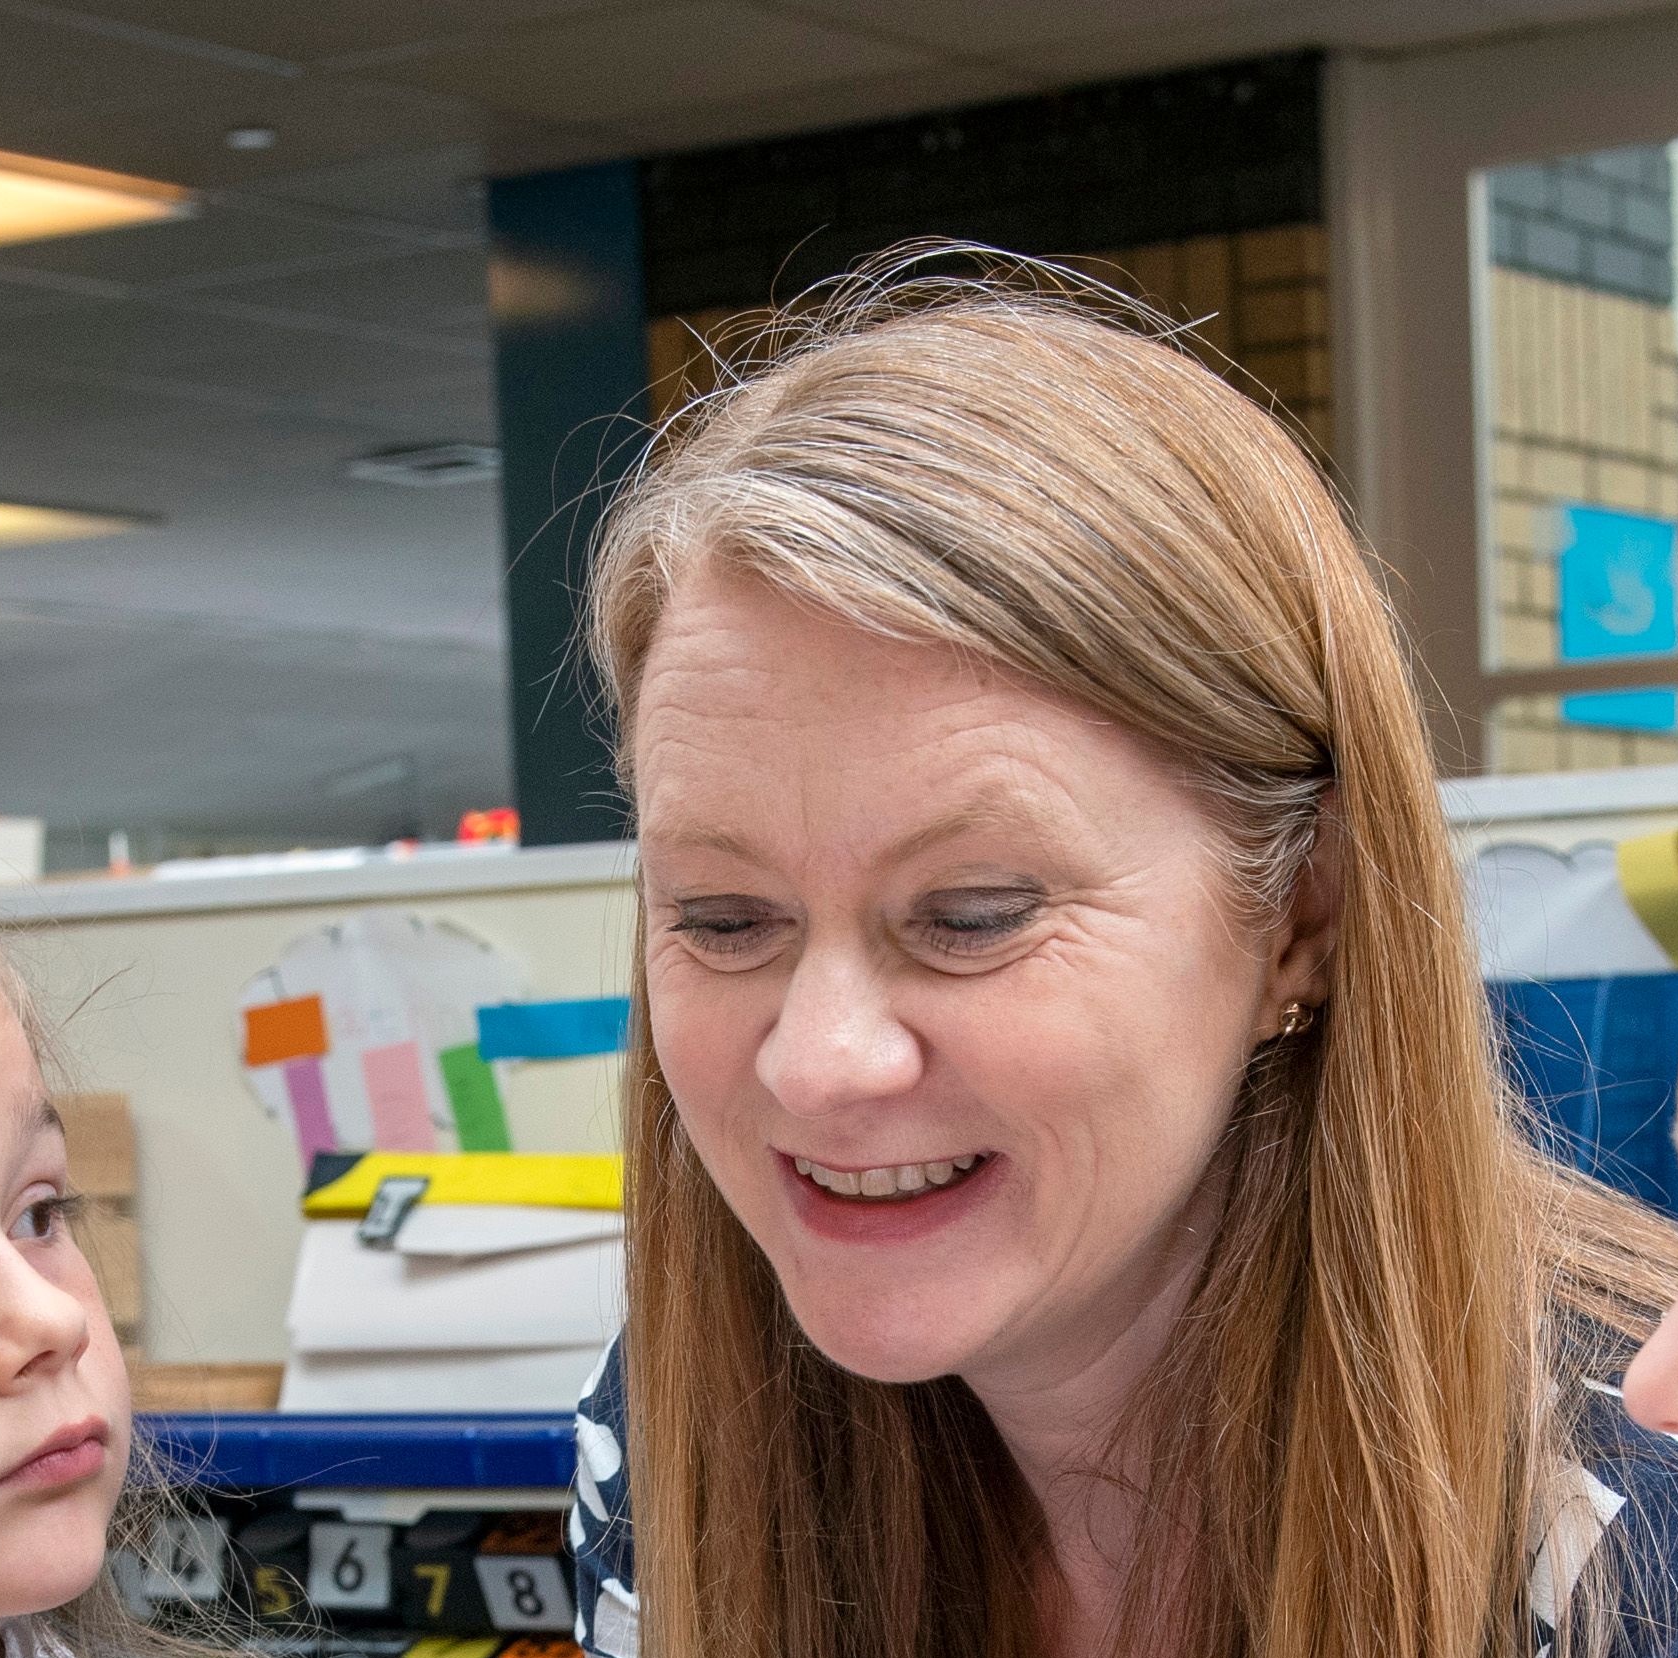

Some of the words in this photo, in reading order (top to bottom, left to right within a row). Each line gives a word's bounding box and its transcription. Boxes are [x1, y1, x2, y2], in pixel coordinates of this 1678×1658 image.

[333, 1537, 364, 1592] 6
[412, 1563, 450, 1617] 7
[508, 1569, 544, 1617] 8
